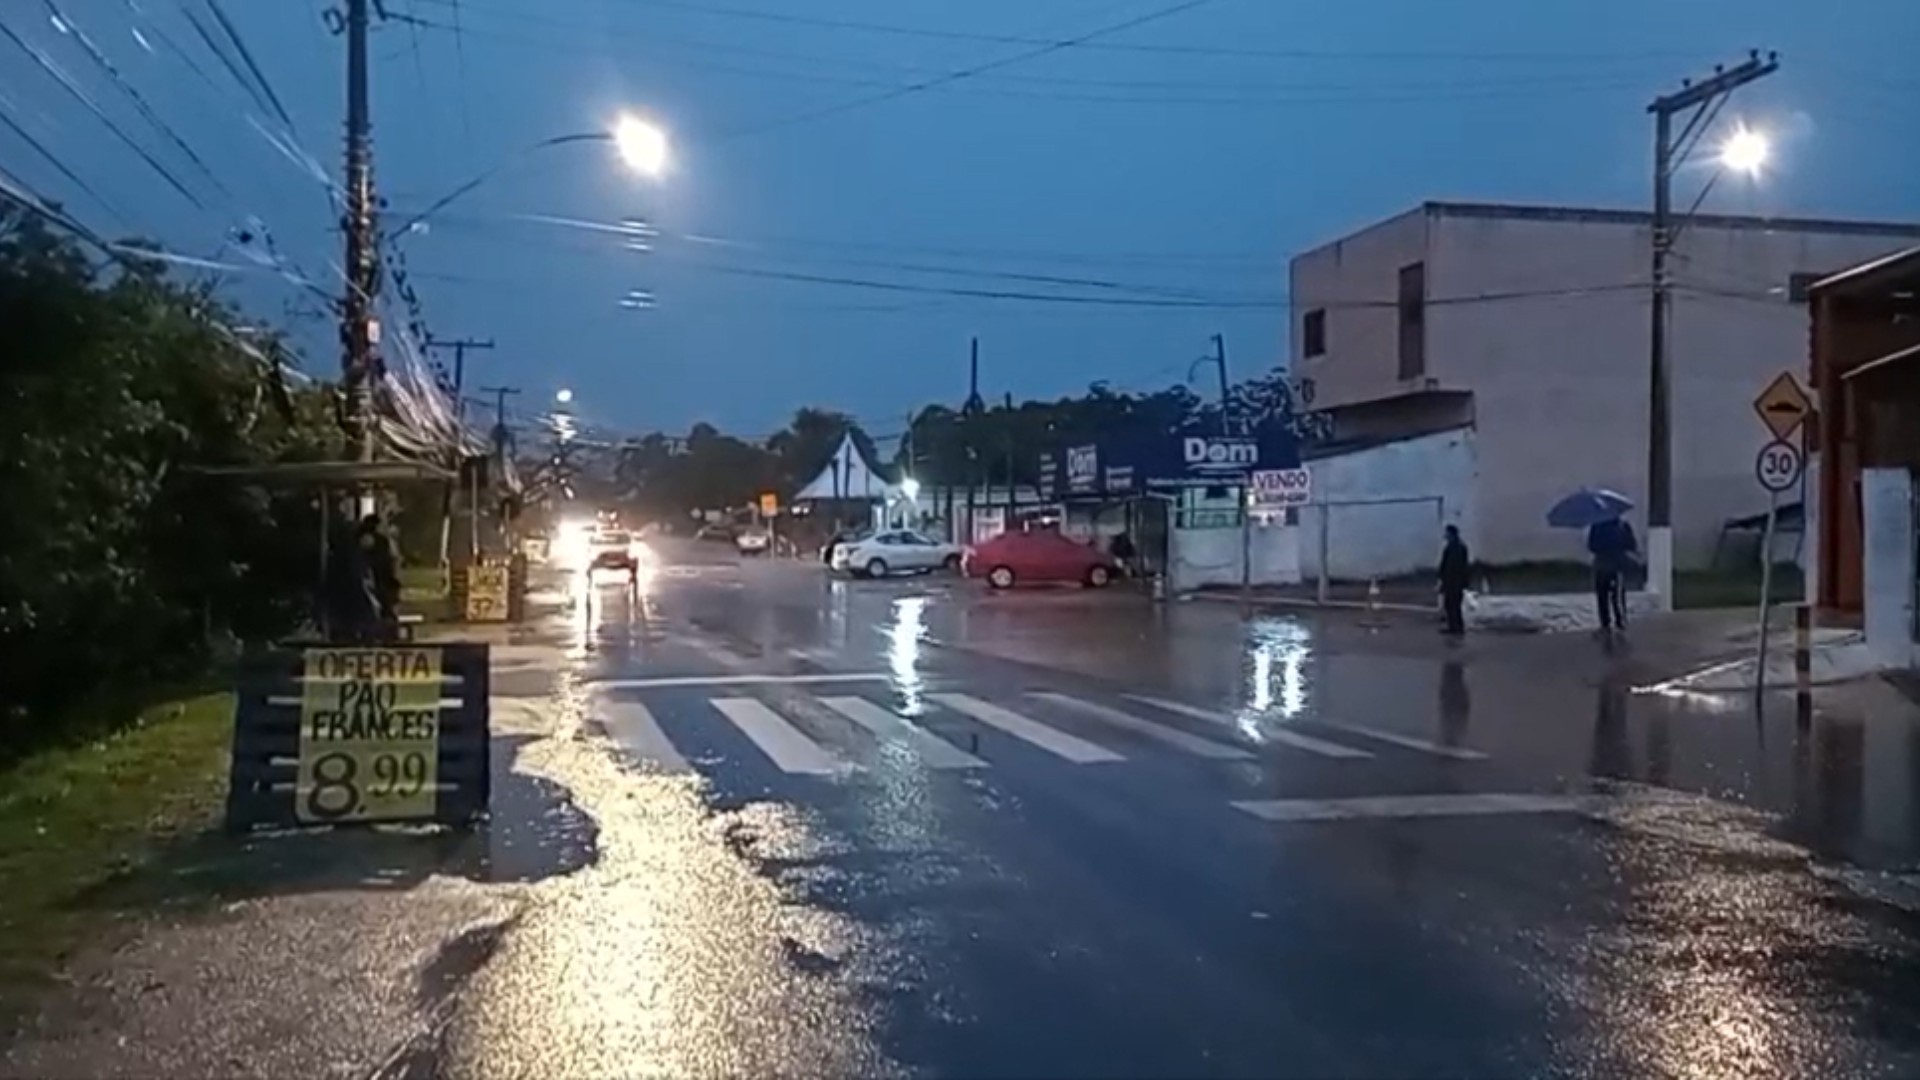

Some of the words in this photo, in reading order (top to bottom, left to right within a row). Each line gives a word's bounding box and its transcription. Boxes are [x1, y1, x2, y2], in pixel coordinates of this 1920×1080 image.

[1765, 453, 1792, 475] 30
[1255, 471, 1308, 489] VENDO
[319, 652, 430, 679] OFERTA
[311, 710, 434, 742] FRANCES
